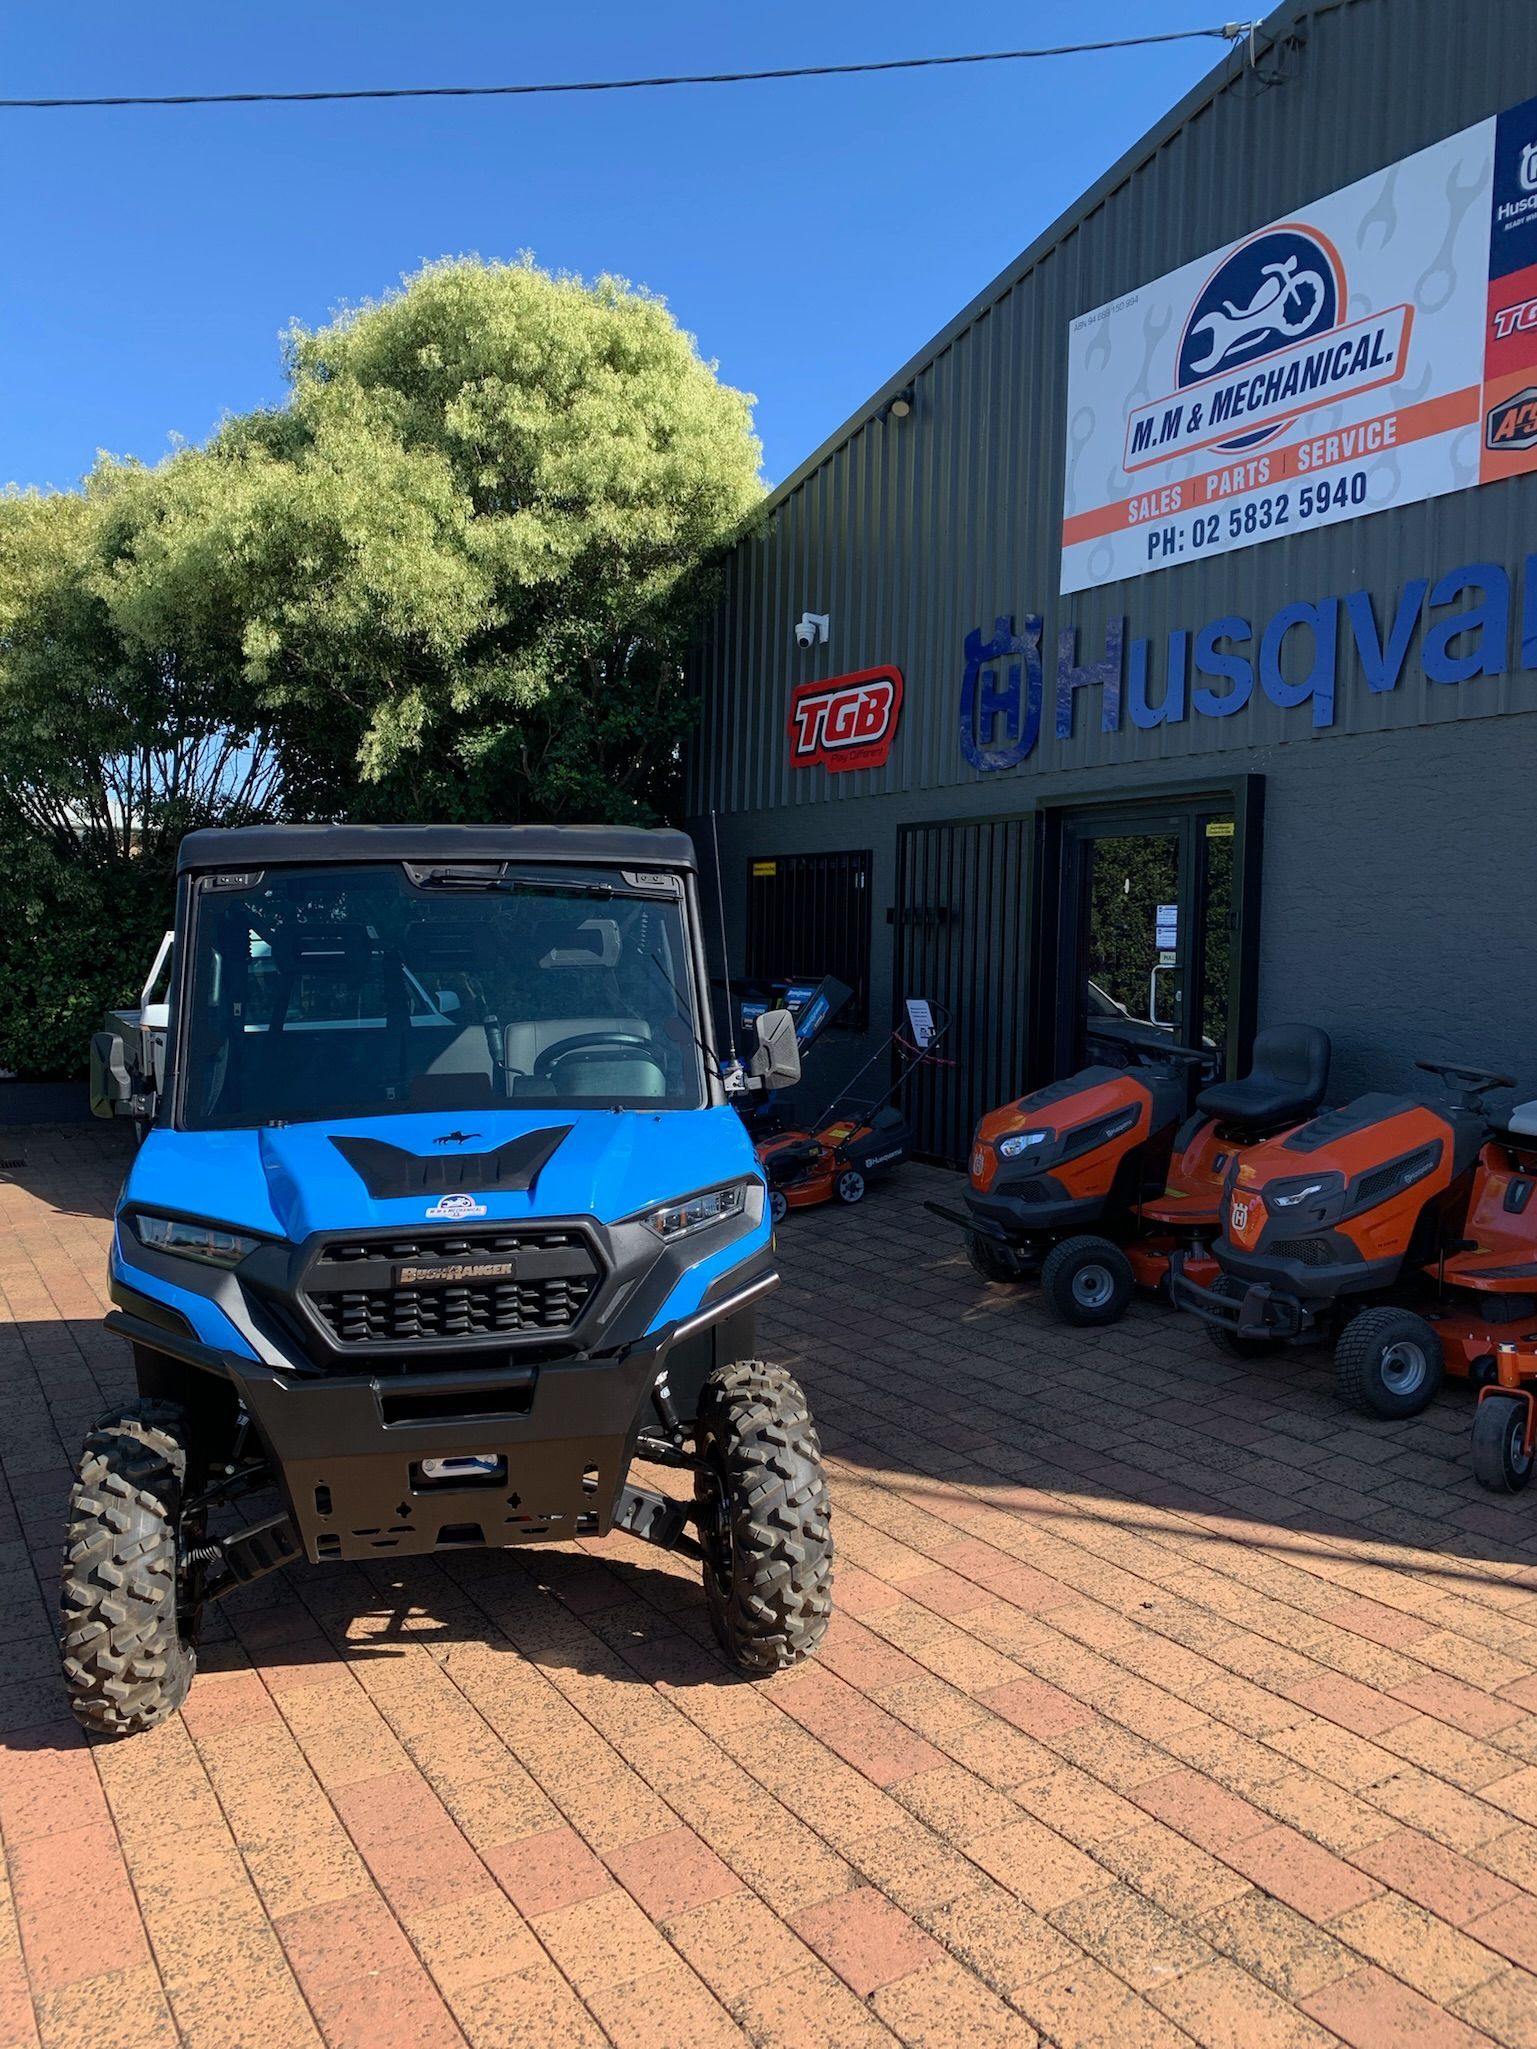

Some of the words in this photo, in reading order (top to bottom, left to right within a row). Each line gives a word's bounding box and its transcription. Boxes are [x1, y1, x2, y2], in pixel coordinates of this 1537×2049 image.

[1131, 405, 1184, 454] M.M
[1186, 403, 1202, 433] &
[1208, 328, 1394, 426] MECHANICAL.
[1128, 486, 1182, 523] SALES
[1206, 458, 1270, 499] PARTS
[1298, 416, 1397, 471] SERVICE
[1148, 526, 1184, 560] PH:
[1192, 514, 1220, 548] 02
[1229, 494, 1289, 538] 5832
[1300, 472, 1367, 518] 5940
[795, 681, 894, 753] TGB
